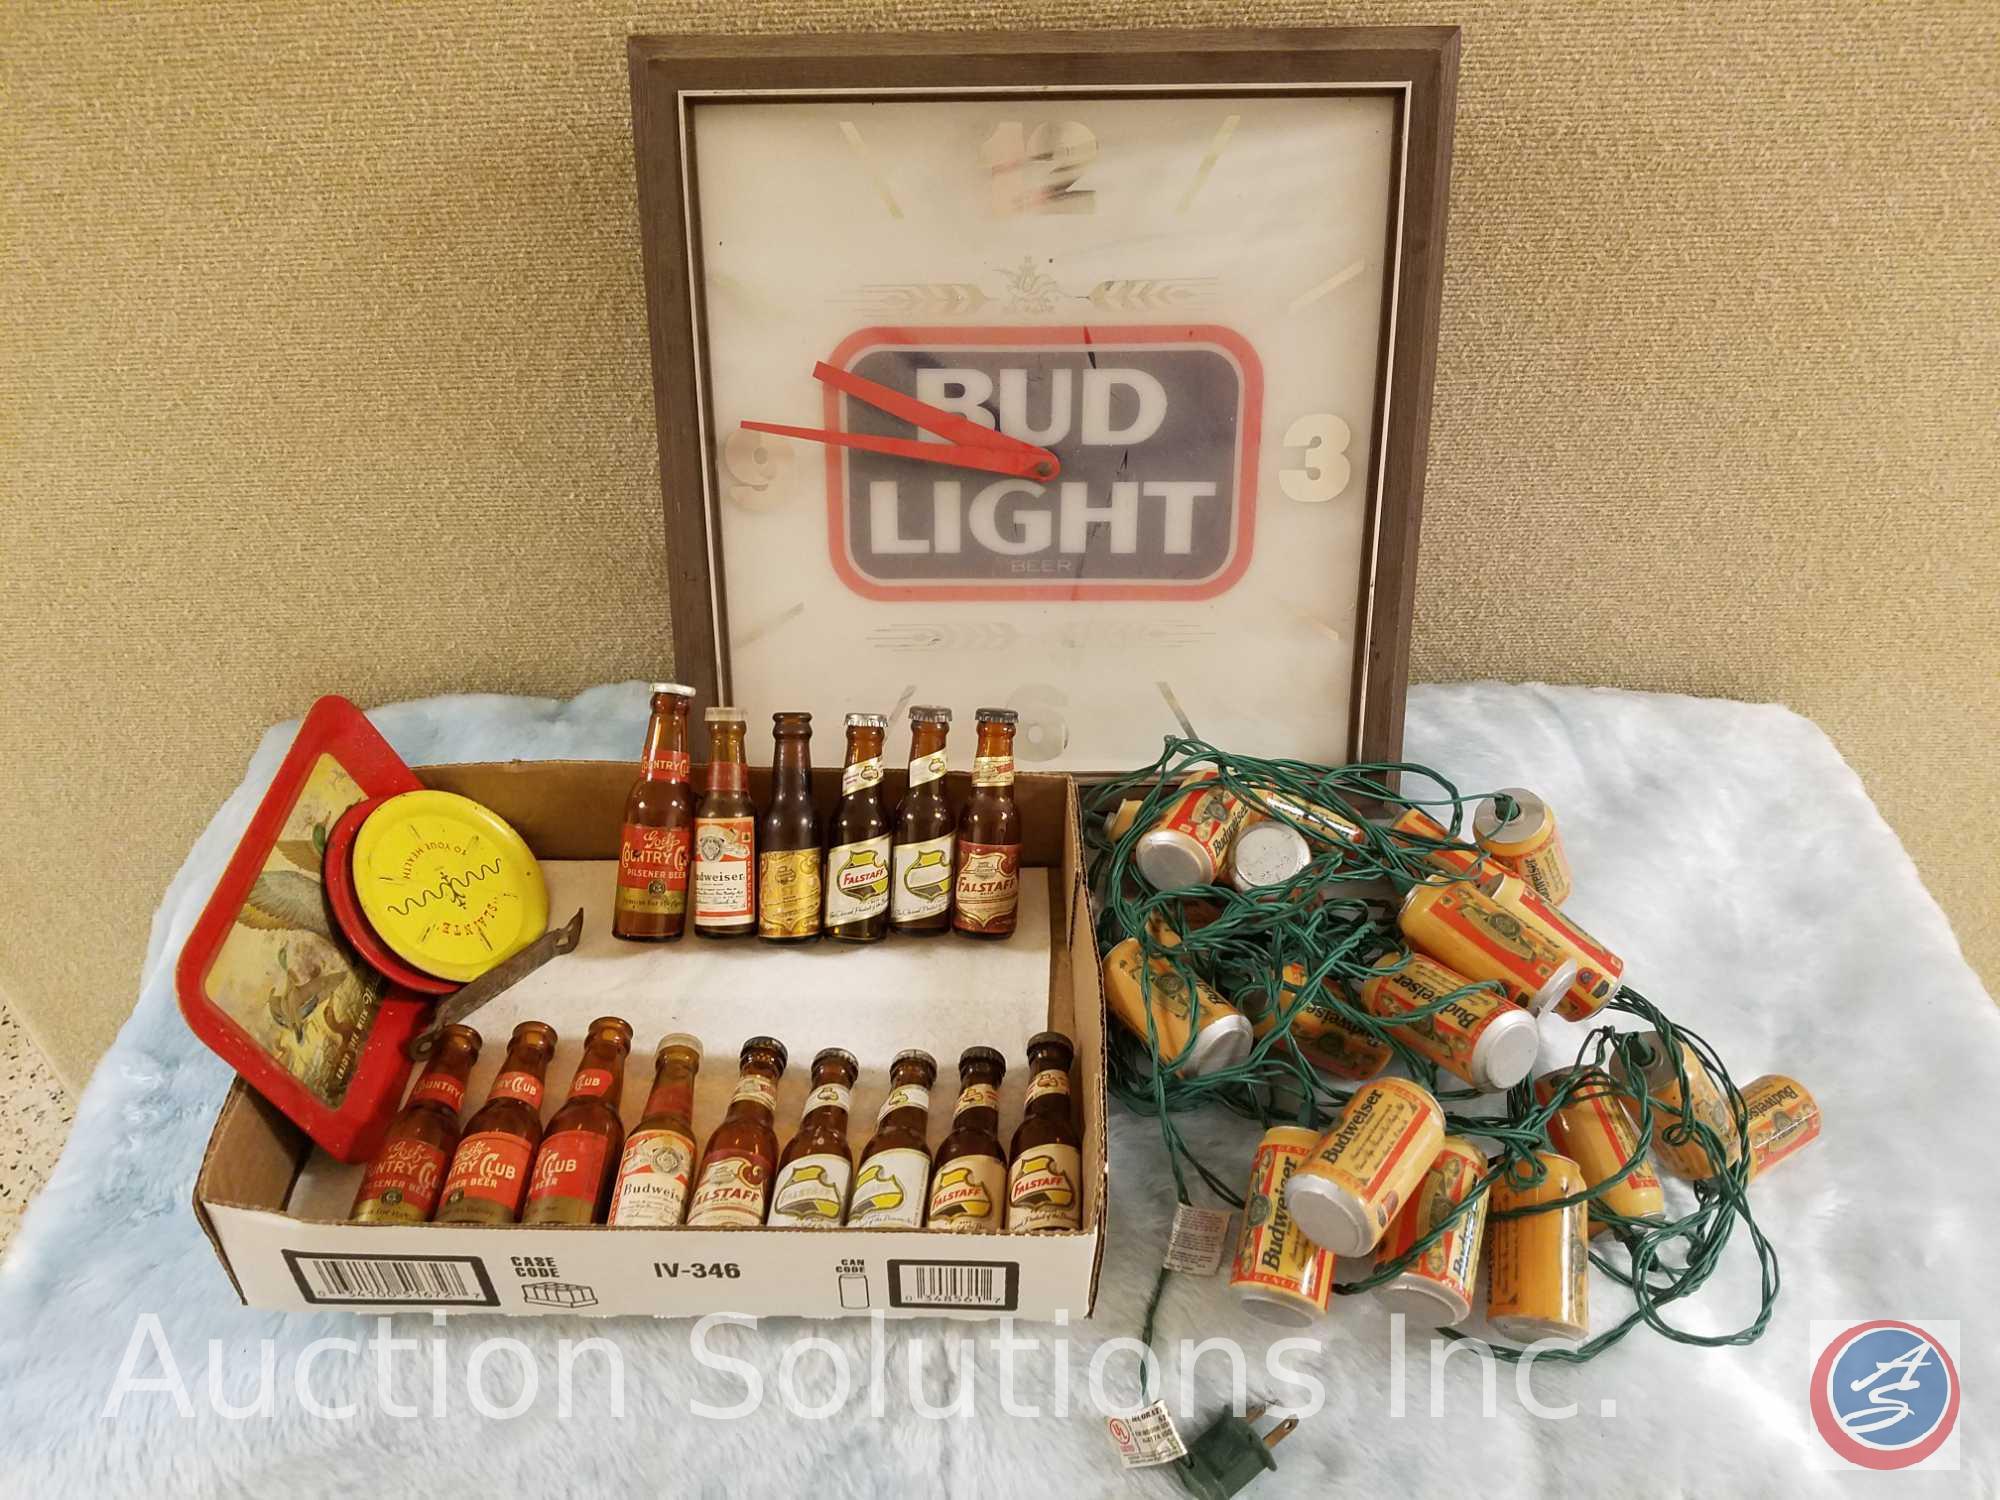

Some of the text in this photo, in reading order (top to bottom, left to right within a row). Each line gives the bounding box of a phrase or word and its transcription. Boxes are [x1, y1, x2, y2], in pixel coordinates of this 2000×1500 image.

[916, 368, 1168, 446] BUD
[1279, 413, 1351, 502] 3
[870, 479, 1217, 555] LIGHT
[1011, 559, 1072, 573] BEER
[622, 842, 673, 868] COUNTRY
[627, 868, 666, 878] PILSENER
[696, 871, 744, 882] dweiser
[843, 868, 885, 886] FALSTAFF
[511, 1076, 537, 1095] CLUB
[1321, 1089, 1383, 1165] Budweiser
[479, 1153, 517, 1180] CLUB
[542, 1152, 577, 1181] CLUB
[932, 1187, 983, 1208] FALSTAFF
[1014, 1177, 1063, 1198] FALSTAFF
[511, 1256, 557, 1267] CASE
[653, 1262, 741, 1279] IV-346
[516, 1267, 560, 1278] CODE
